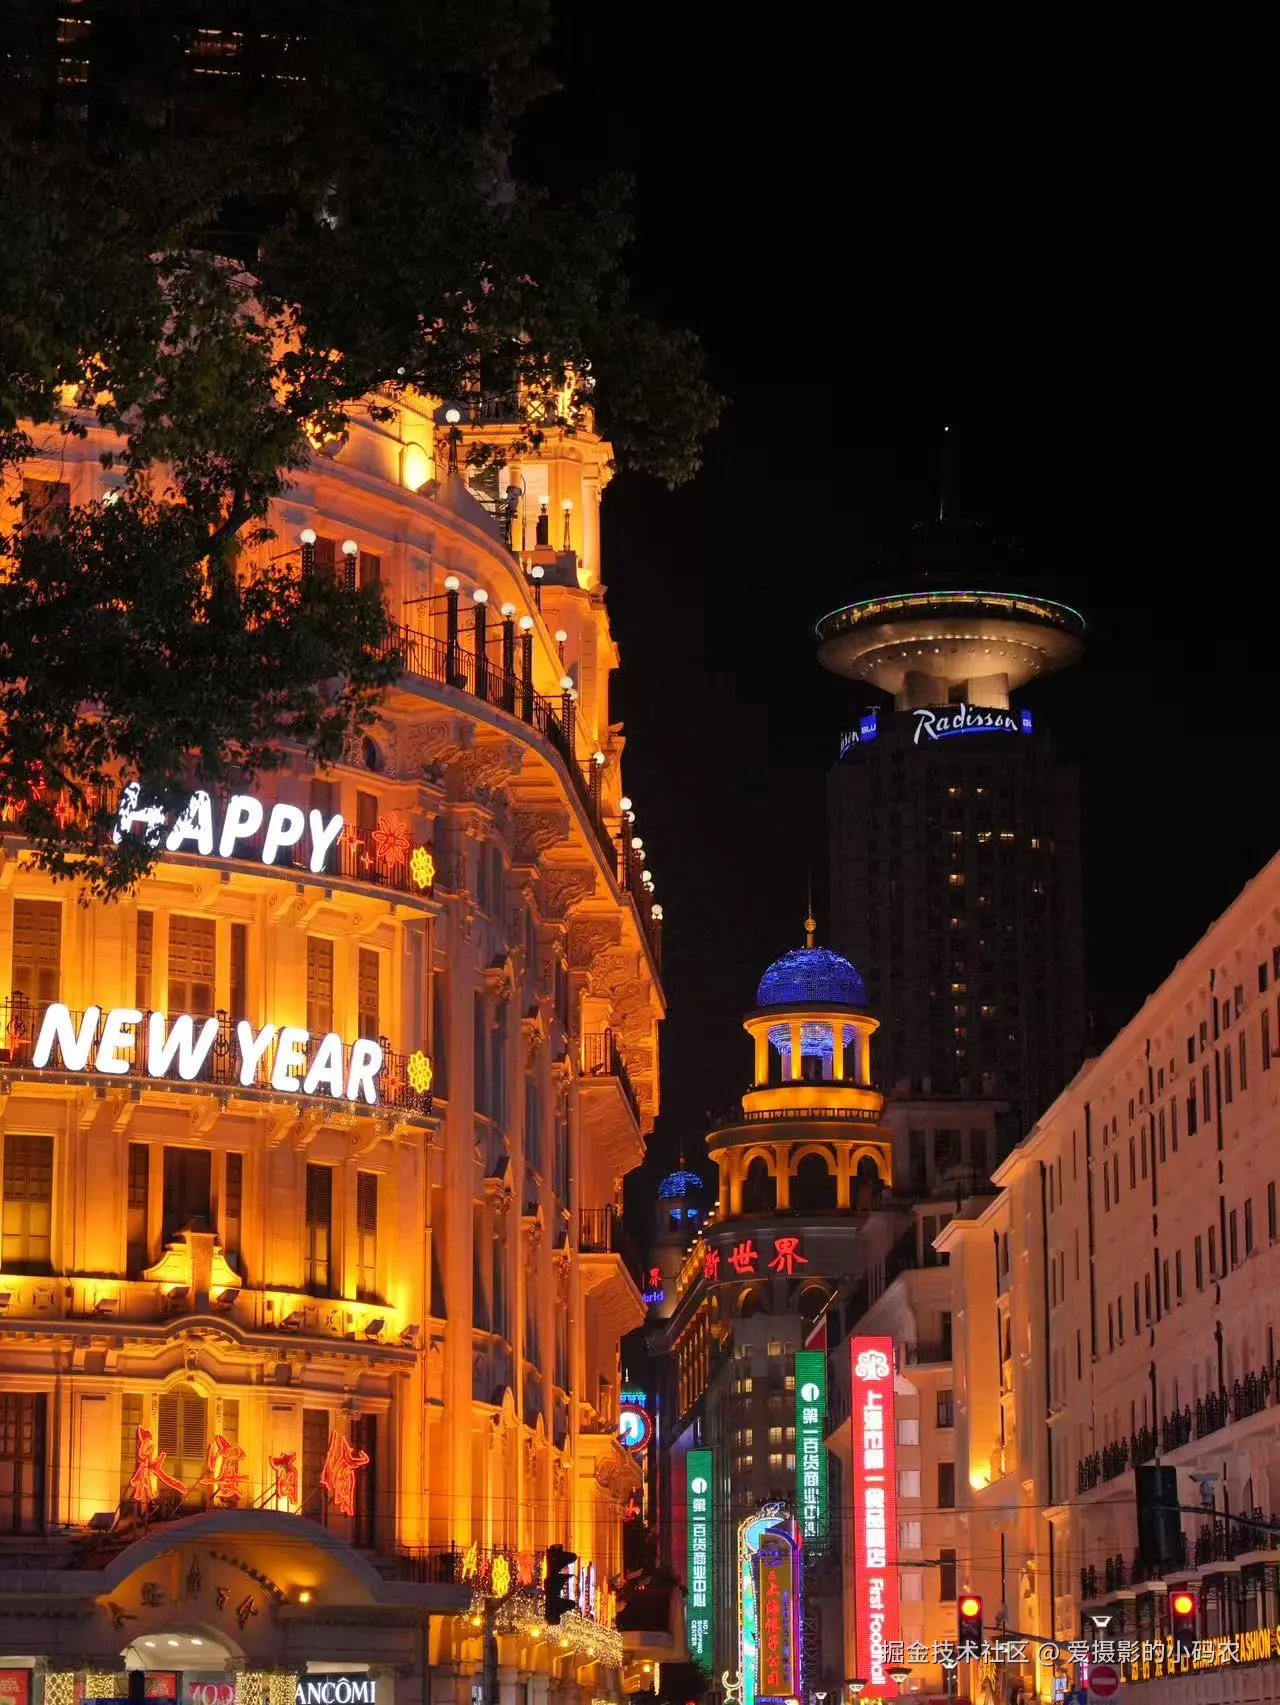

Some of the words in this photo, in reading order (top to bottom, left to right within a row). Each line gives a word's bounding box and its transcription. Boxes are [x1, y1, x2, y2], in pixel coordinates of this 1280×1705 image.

[861, 723, 876, 734] BLU
[912, 702, 1018, 744] Radisson
[113, 781, 343, 873] HAPPY
[32, 1003, 219, 1080] NEW
[236, 1020, 383, 1104] YEAR
[703, 1237, 808, 1281] 新世界
[641, 1290, 664, 1303] orld
[692, 1498, 707, 1608] 第一百货商业中心
[869, 1578, 885, 1609] First
[870, 1613, 886, 1685] Foodhall
